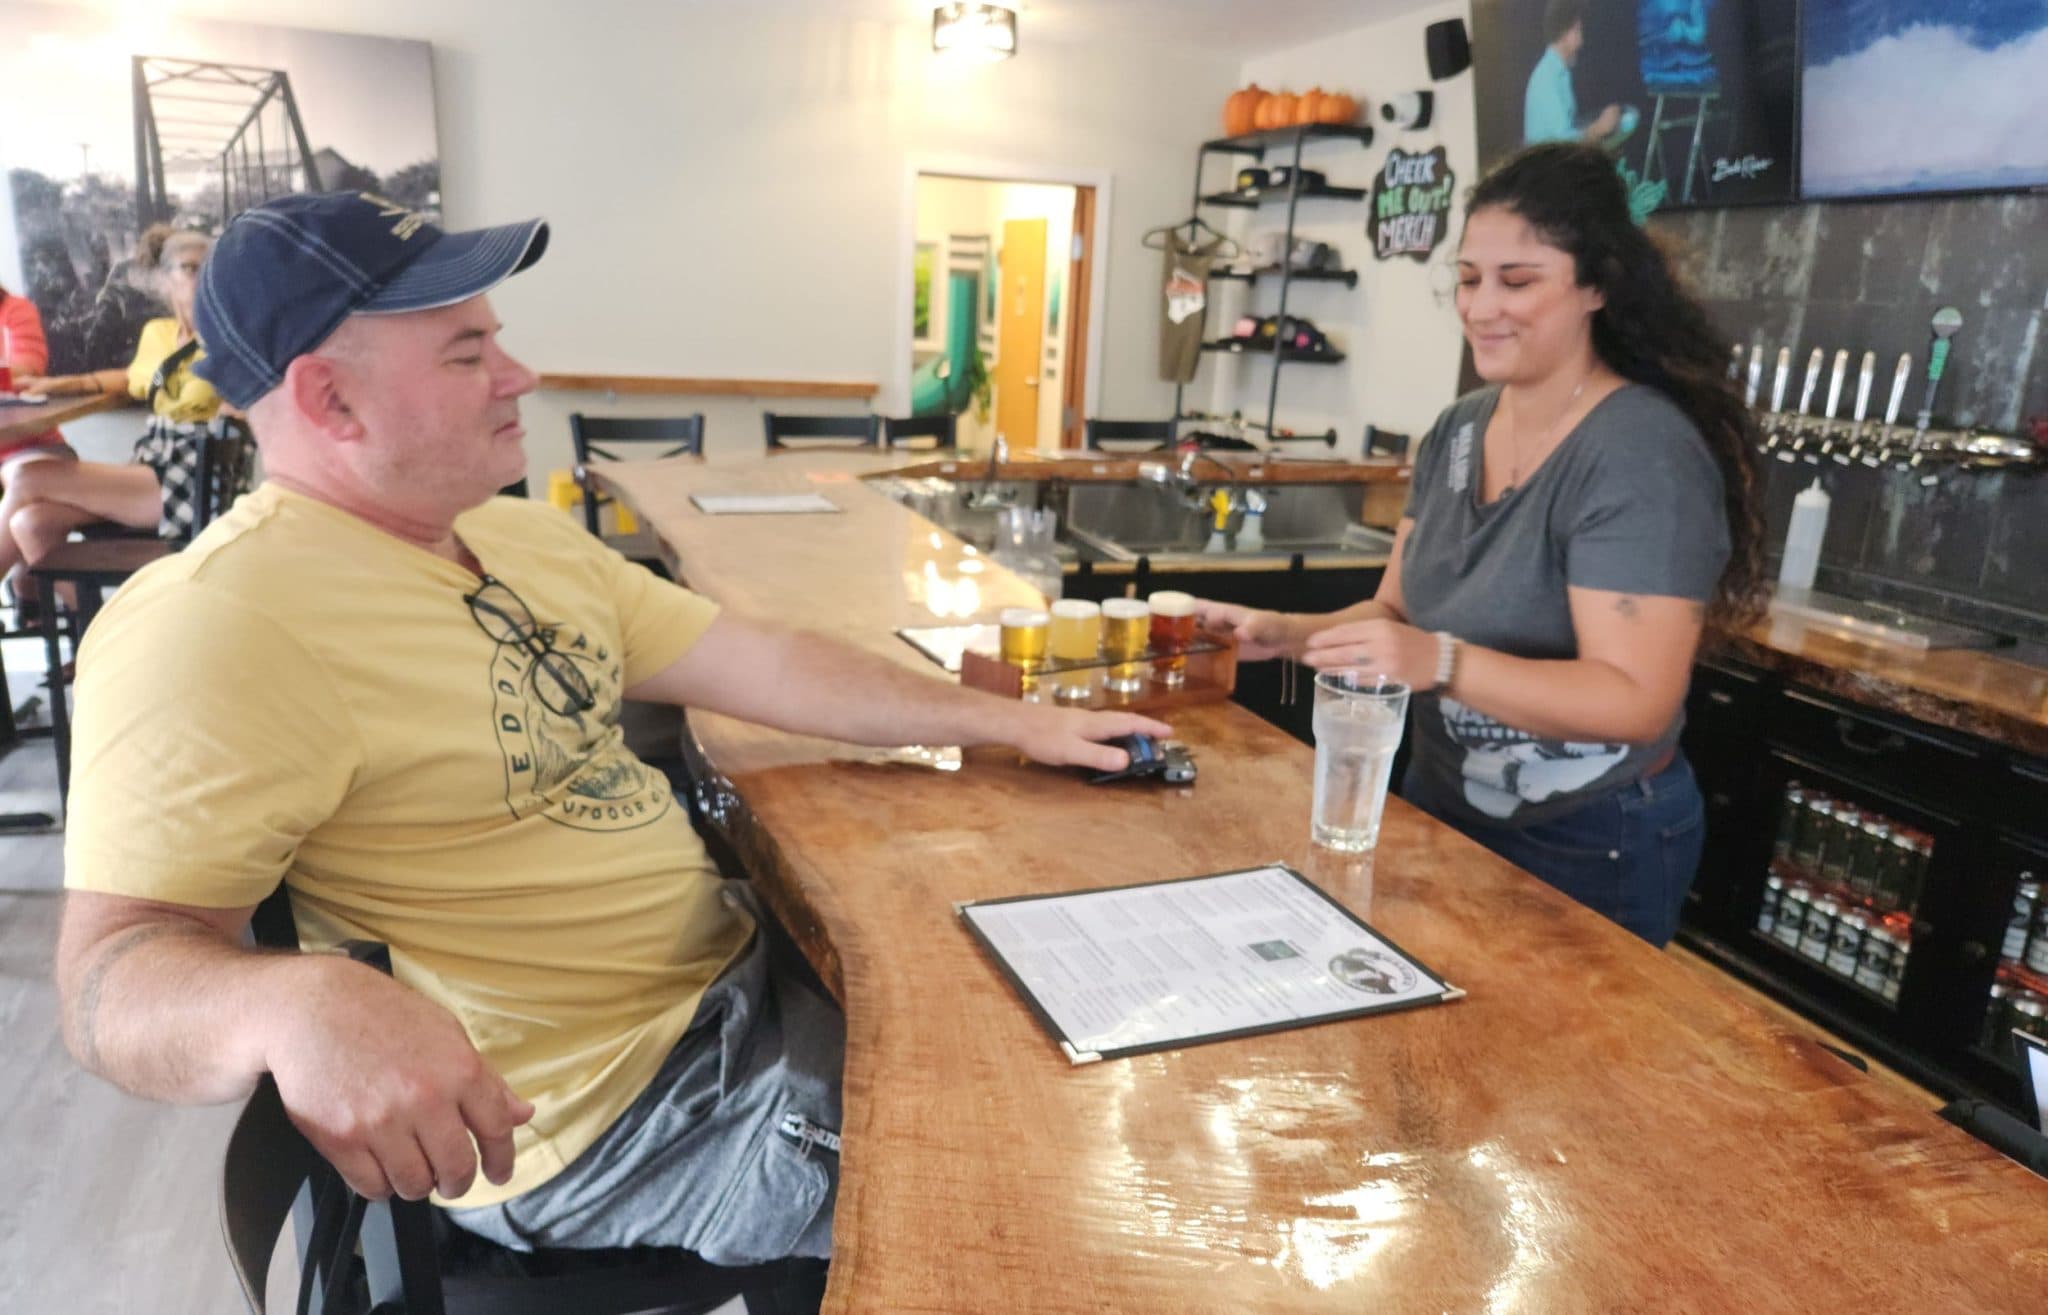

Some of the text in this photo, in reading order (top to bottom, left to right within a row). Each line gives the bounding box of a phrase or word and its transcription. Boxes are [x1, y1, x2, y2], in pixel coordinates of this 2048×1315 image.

[1378, 186, 1404, 219] ME
[1378, 214, 1437, 253] MERCH
[562, 798, 647, 821] UTDOOR
